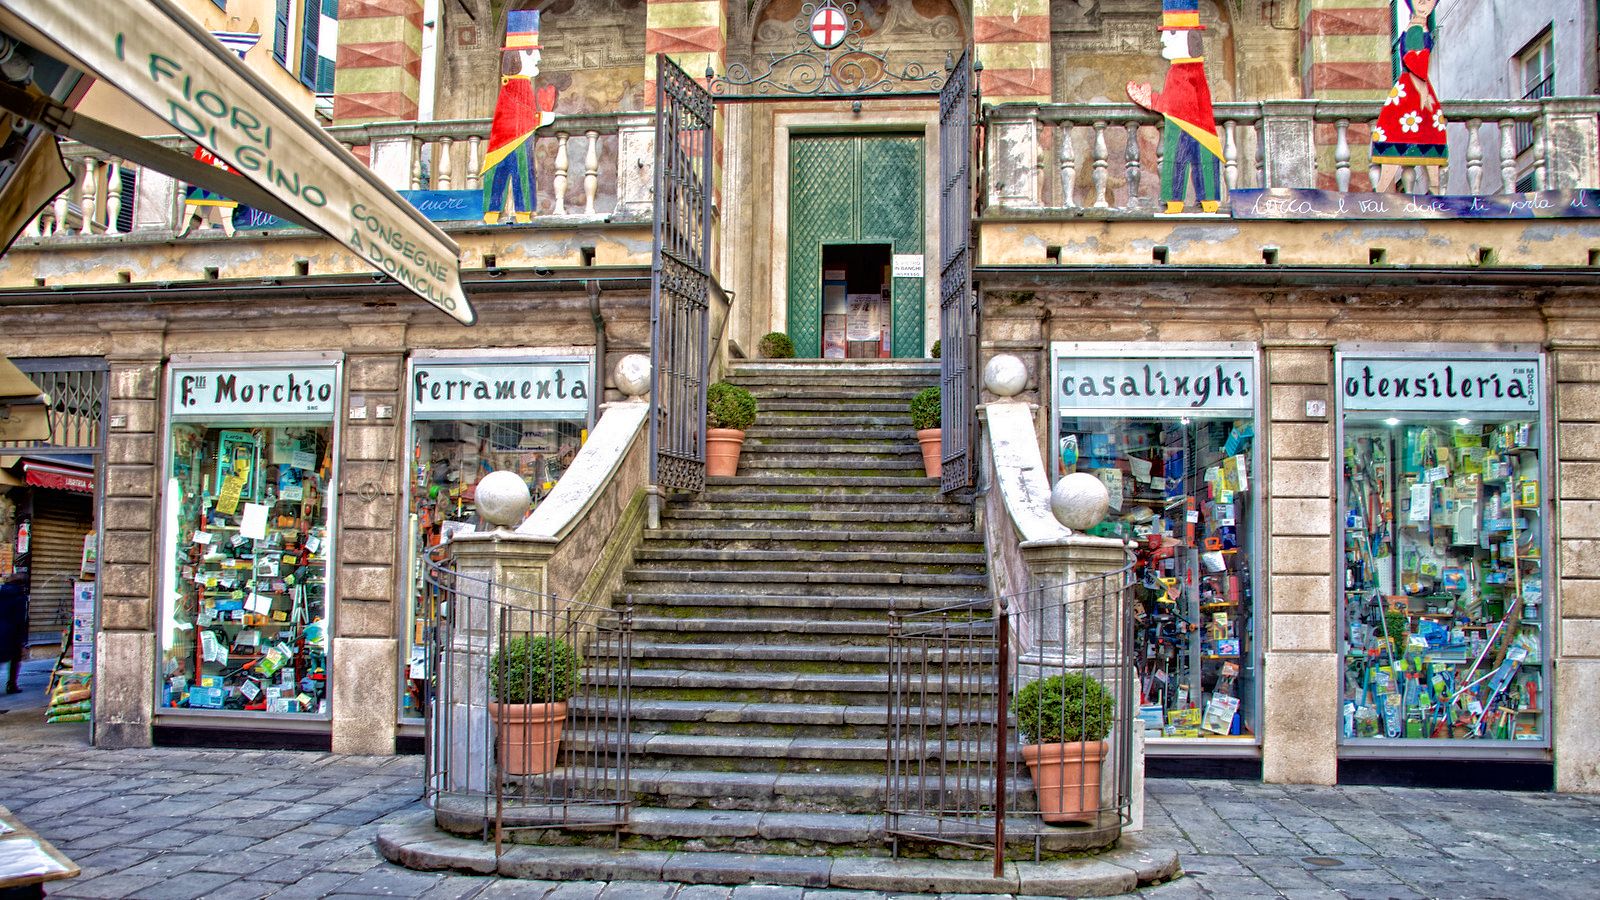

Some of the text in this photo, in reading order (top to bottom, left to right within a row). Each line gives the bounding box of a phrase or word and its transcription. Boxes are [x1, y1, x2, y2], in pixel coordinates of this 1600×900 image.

[114, 31, 272, 150] I FIORI
[167, 99, 327, 208] DI GINO
[351, 203, 448, 283] CONSEGNE
[418, 197, 468, 211] cuore
[350, 228, 456, 311] A DOMICILIO
[214, 373, 332, 403] Morchio
[1061, 363, 1249, 408] casalinghi
